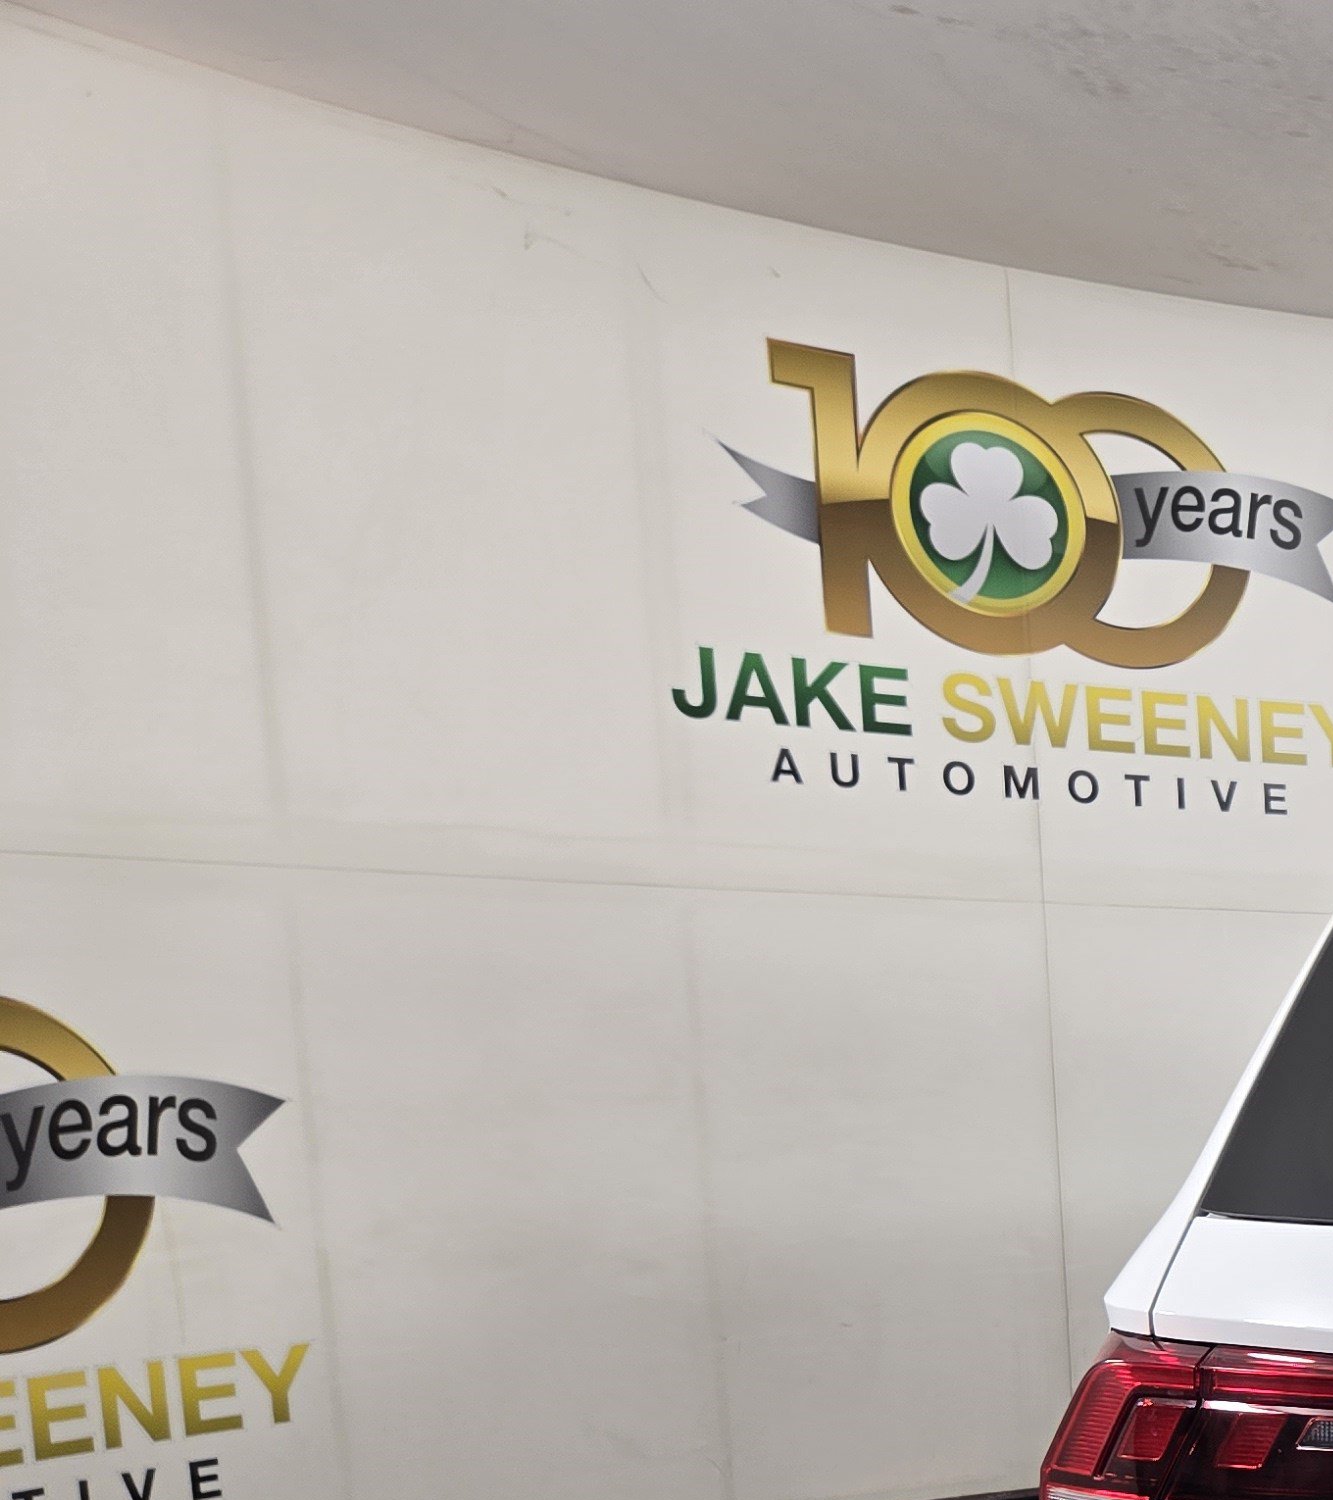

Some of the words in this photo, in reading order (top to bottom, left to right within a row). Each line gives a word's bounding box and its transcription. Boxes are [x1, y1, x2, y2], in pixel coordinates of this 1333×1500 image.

[766, 337, 1250, 670] 100
[1134, 482, 1303, 550] years
[671, 646, 913, 737] JAKE
[771, 747, 1289, 816] AUTOMOTIVE
[0, 1093, 218, 1193] years
